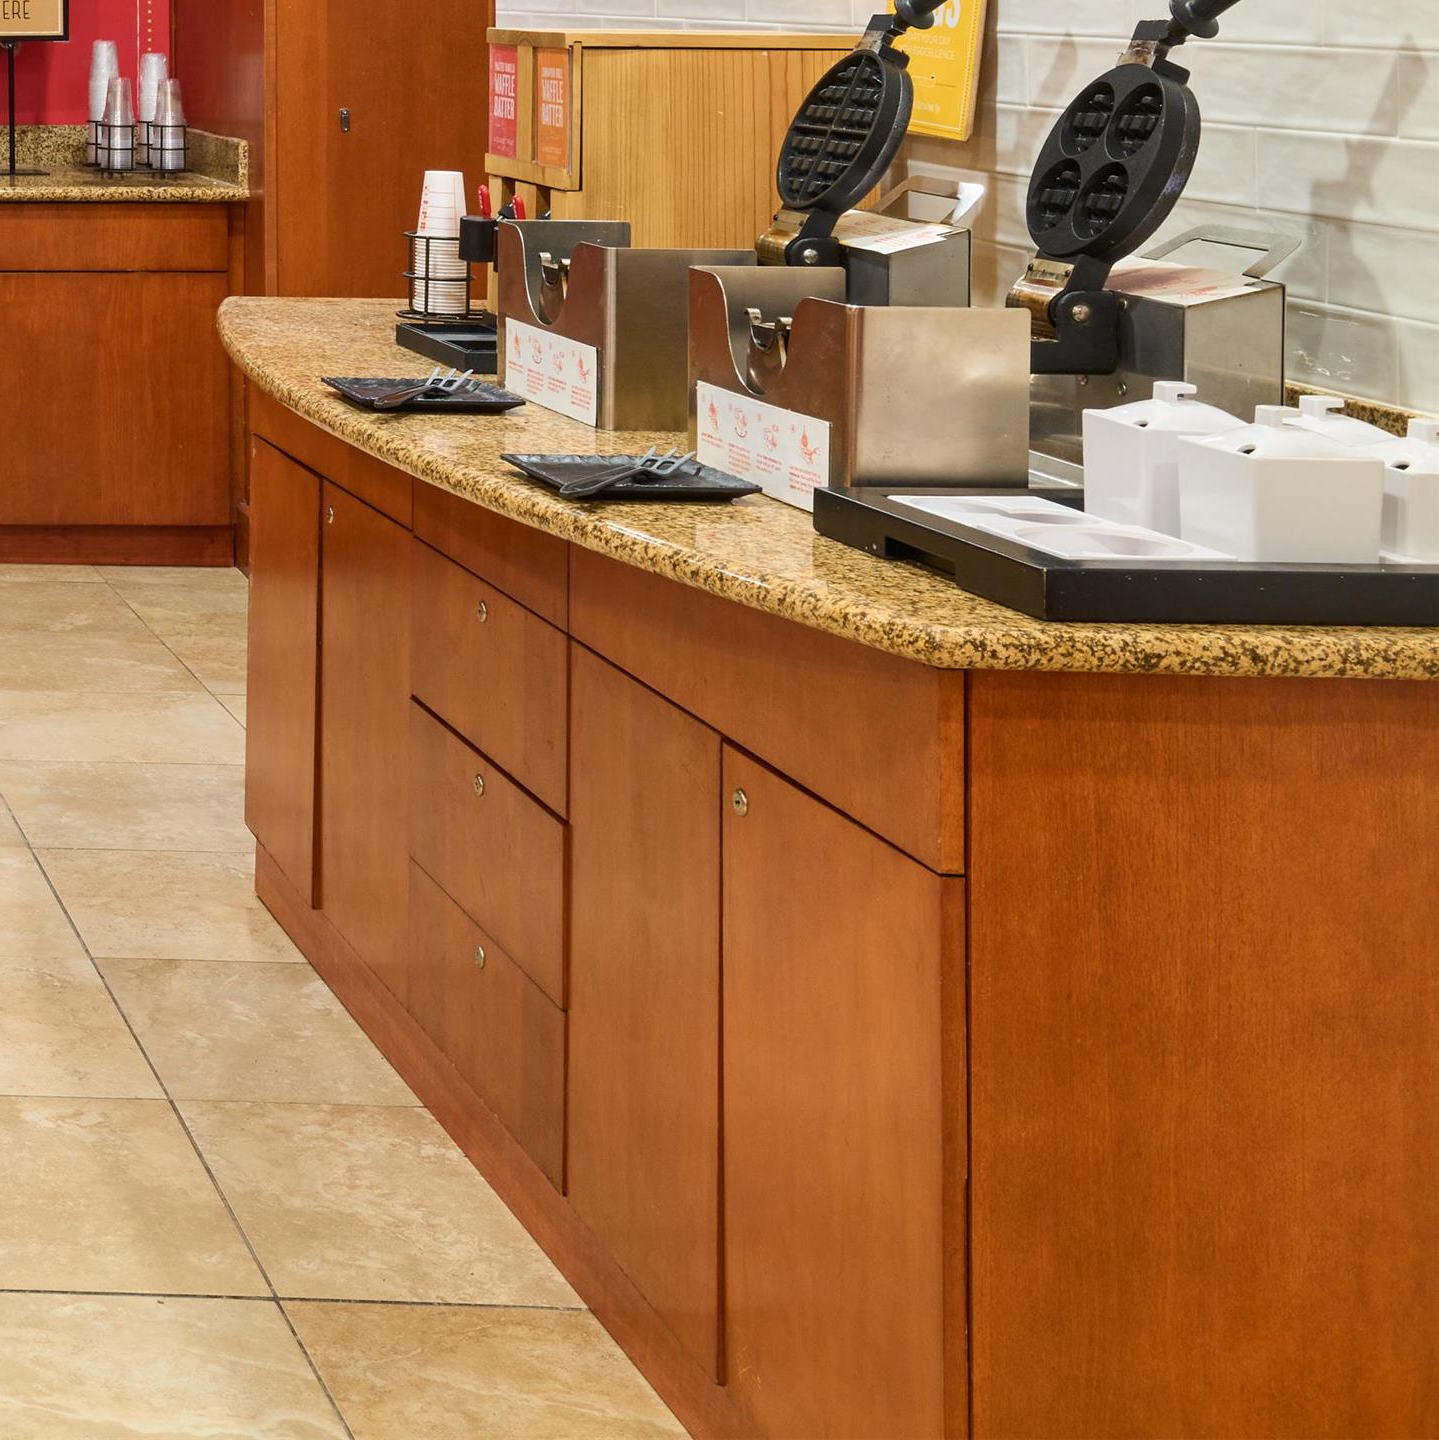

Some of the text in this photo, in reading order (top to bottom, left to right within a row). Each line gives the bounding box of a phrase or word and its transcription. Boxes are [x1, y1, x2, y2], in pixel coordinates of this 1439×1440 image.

[494, 72, 515, 97] WAFFLE
[542, 79, 563, 104] WAFFLE
[494, 96, 514, 120] BATTER
[542, 104, 563, 128] BATTER
